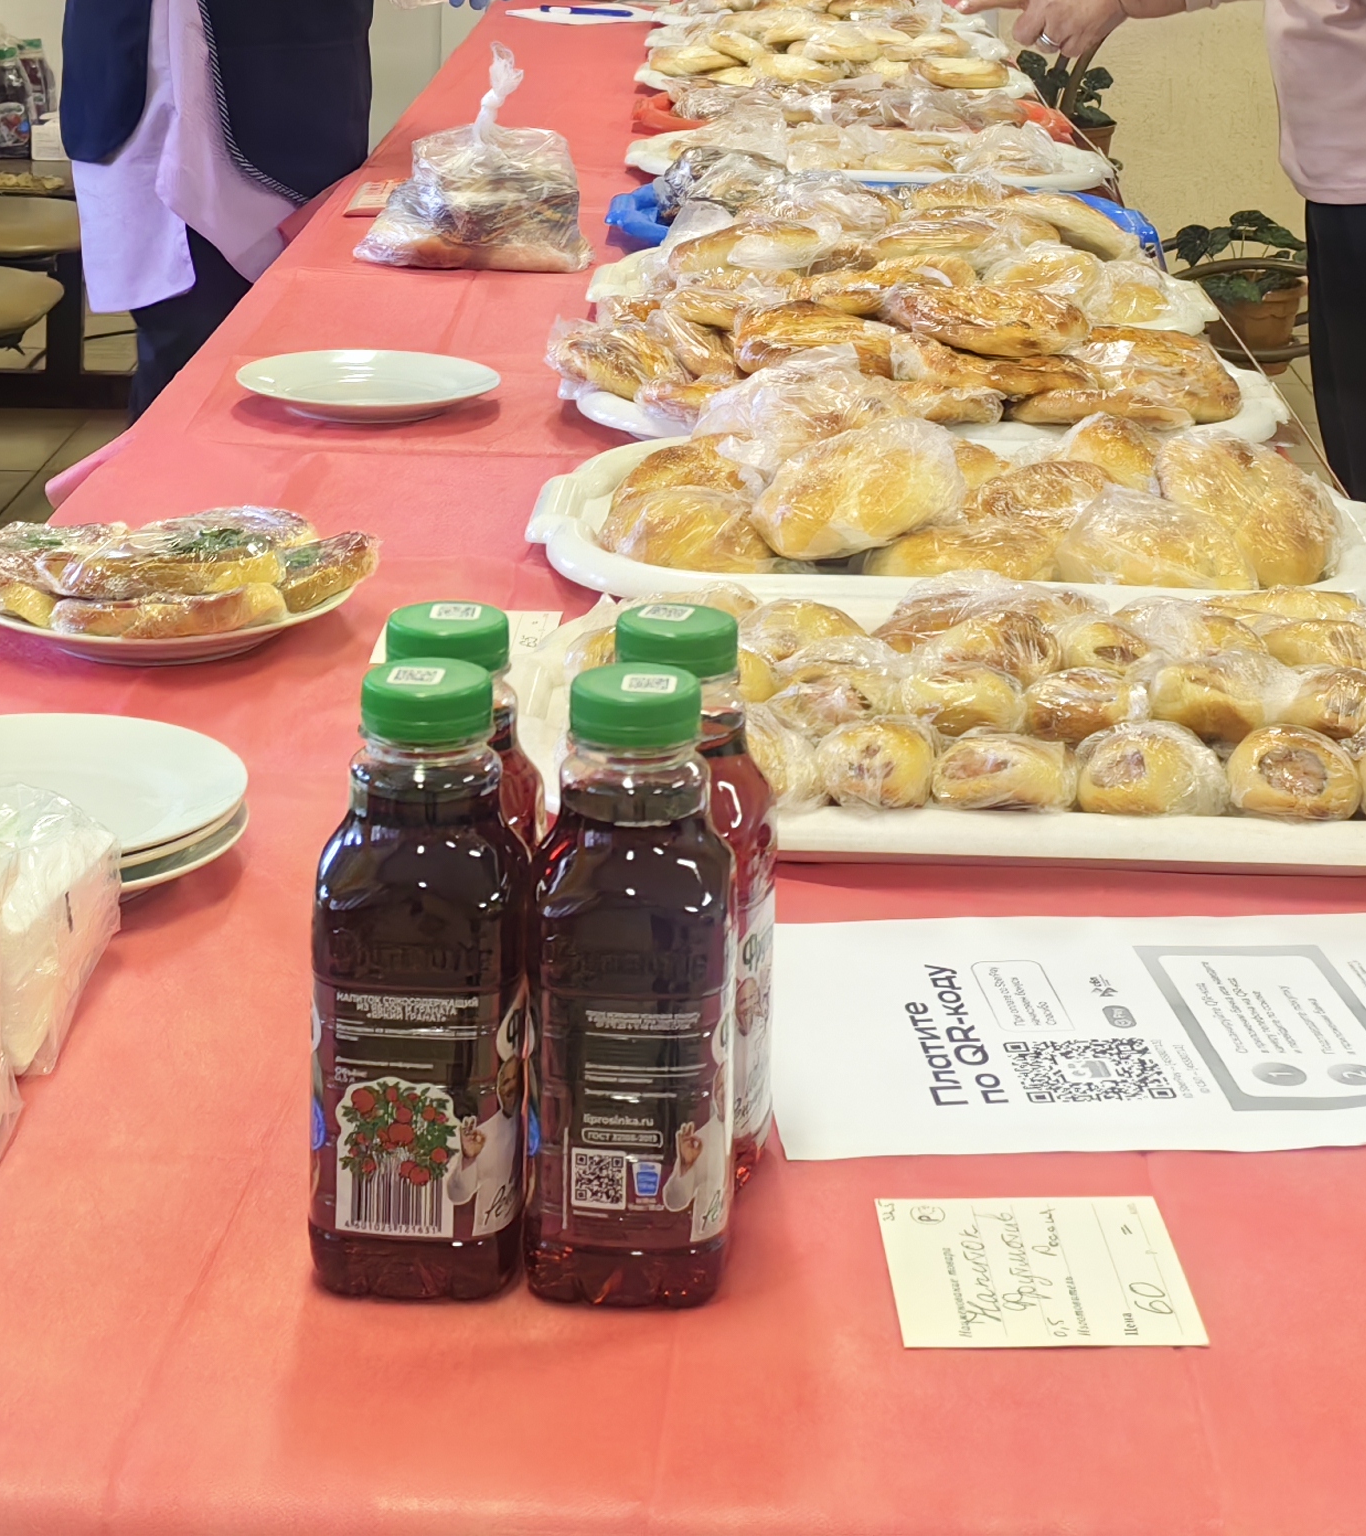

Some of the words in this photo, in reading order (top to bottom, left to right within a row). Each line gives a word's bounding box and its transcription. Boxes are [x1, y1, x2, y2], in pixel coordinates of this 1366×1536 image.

[924, 964, 990, 1066] QR-коду
[905, 1001, 969, 1106] Платите
[975, 1073, 1009, 1104] по
[1129, 1282, 1174, 1315] 60
[1122, 1312, 1138, 1336] Цена
